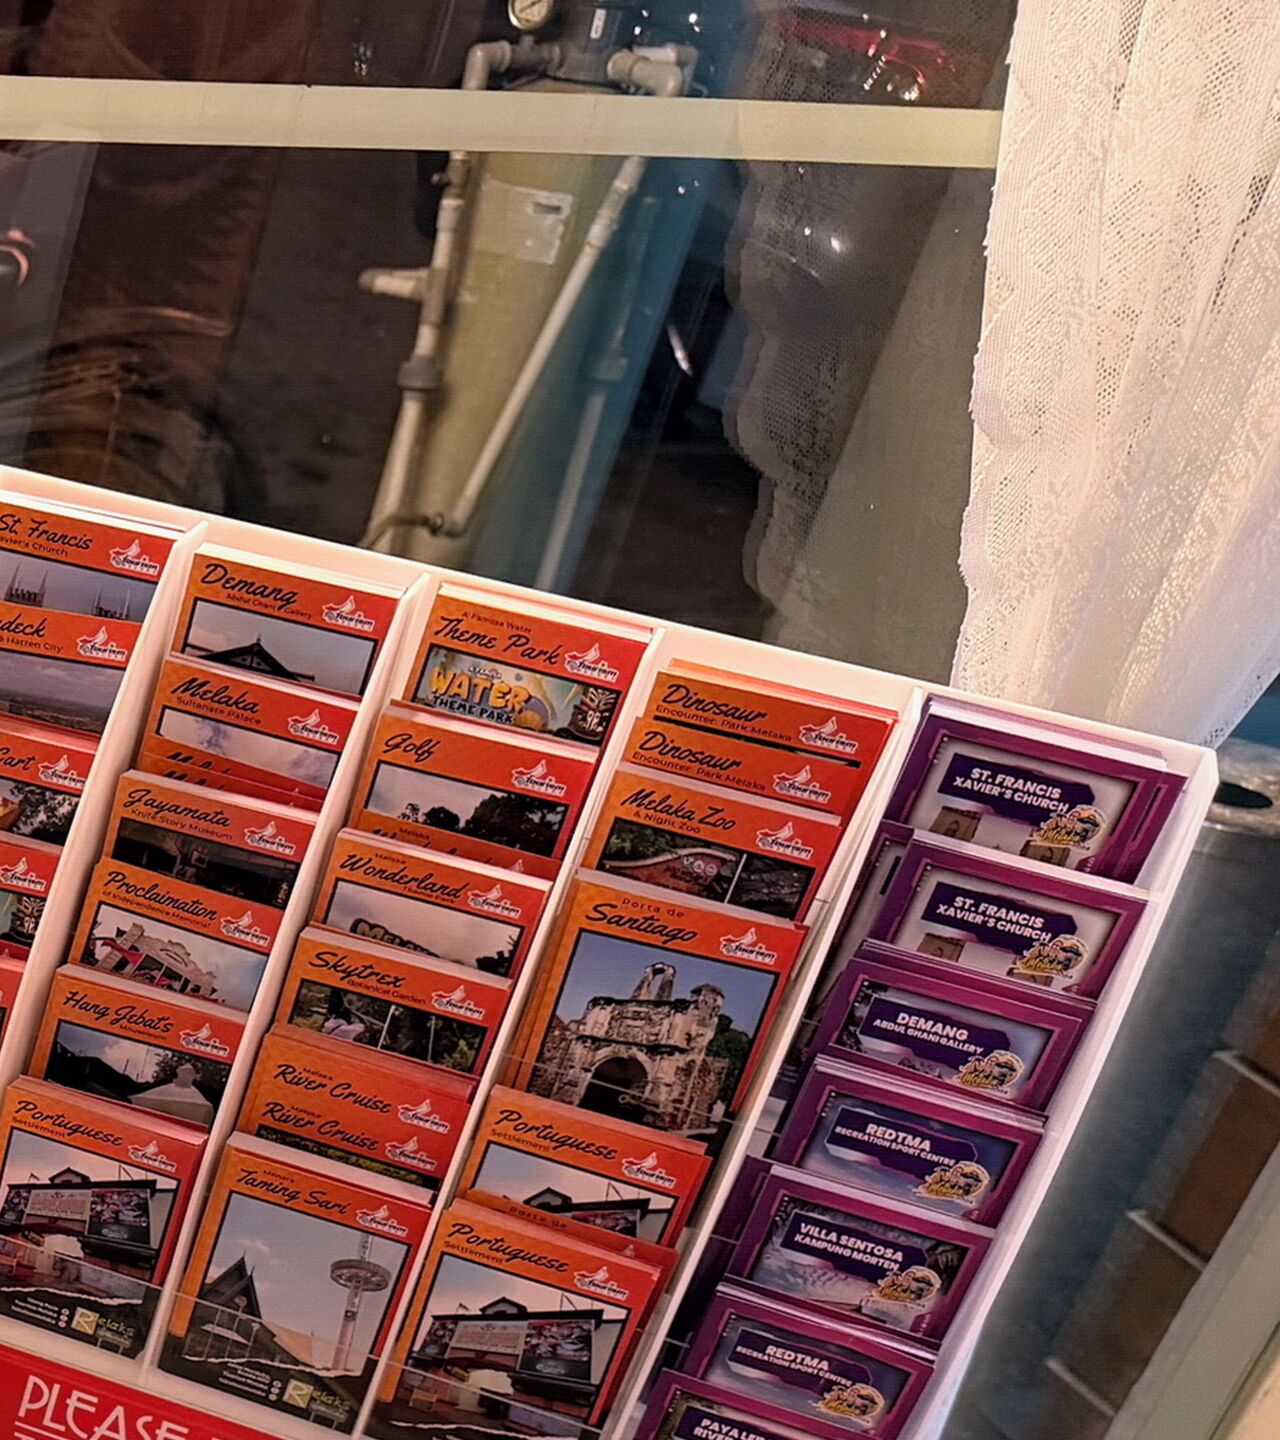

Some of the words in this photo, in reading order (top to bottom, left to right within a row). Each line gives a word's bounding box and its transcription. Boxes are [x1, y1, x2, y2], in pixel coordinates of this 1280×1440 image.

[28, 518, 93, 549] Francis
[201, 563, 298, 610] Demang
[435, 616, 496, 649] Theme
[503, 634, 562, 665] Park
[172, 678, 258, 714] Melaka
[661, 684, 768, 722] Dinosaur
[383, 733, 440, 763] Golf
[639, 730, 742, 770] Dinosaur
[953, 777, 1013, 799] XAVIER'S
[1014, 791, 1069, 813] CHURCH
[971, 768, 991, 782] ST.
[995, 774, 1061, 799] FRANCIS
[124, 789, 230, 827] Jayamata
[621, 789, 695, 821] Melaka
[699, 807, 737, 831] Zoo
[340, 854, 469, 899] Wonderland
[104, 871, 217, 921] Proclaimation
[954, 897, 975, 911] ST.
[977, 903, 1045, 928] FRANCIS
[586, 903, 698, 944] Santiago
[937, 904, 995, 927] XAVIER'S
[996, 920, 1051, 942] CHURCH
[309, 952, 406, 987] Skytrex
[63, 990, 110, 1020] Hang
[873, 1019, 906, 1034] ABDUL
[907, 1027, 939, 1042] GHANI
[939, 1037, 983, 1054] GALLERY
[896, 1013, 969, 1040] DEMANG
[274, 1064, 327, 1090] River
[331, 1083, 392, 1114] Cruise
[17, 1101, 123, 1146] Portuguese
[262, 1103, 314, 1128] River
[318, 1121, 379, 1151] Cruise
[495, 1109, 618, 1159] Portuguese
[866, 1124, 931, 1151] REDTMA
[238, 1169, 302, 1202] Taming
[304, 1191, 349, 1214] Sari
[448, 1222, 569, 1272] Portuguese
[794, 1234, 851, 1257] KAMPUNG
[852, 1251, 899, 1270] MORTEN
[800, 1223, 837, 1242] VILLA
[840, 1235, 903, 1262] SENTOSA
[765, 1345, 829, 1370] REDTMA
[701, 1419, 739, 1438] PAYA
